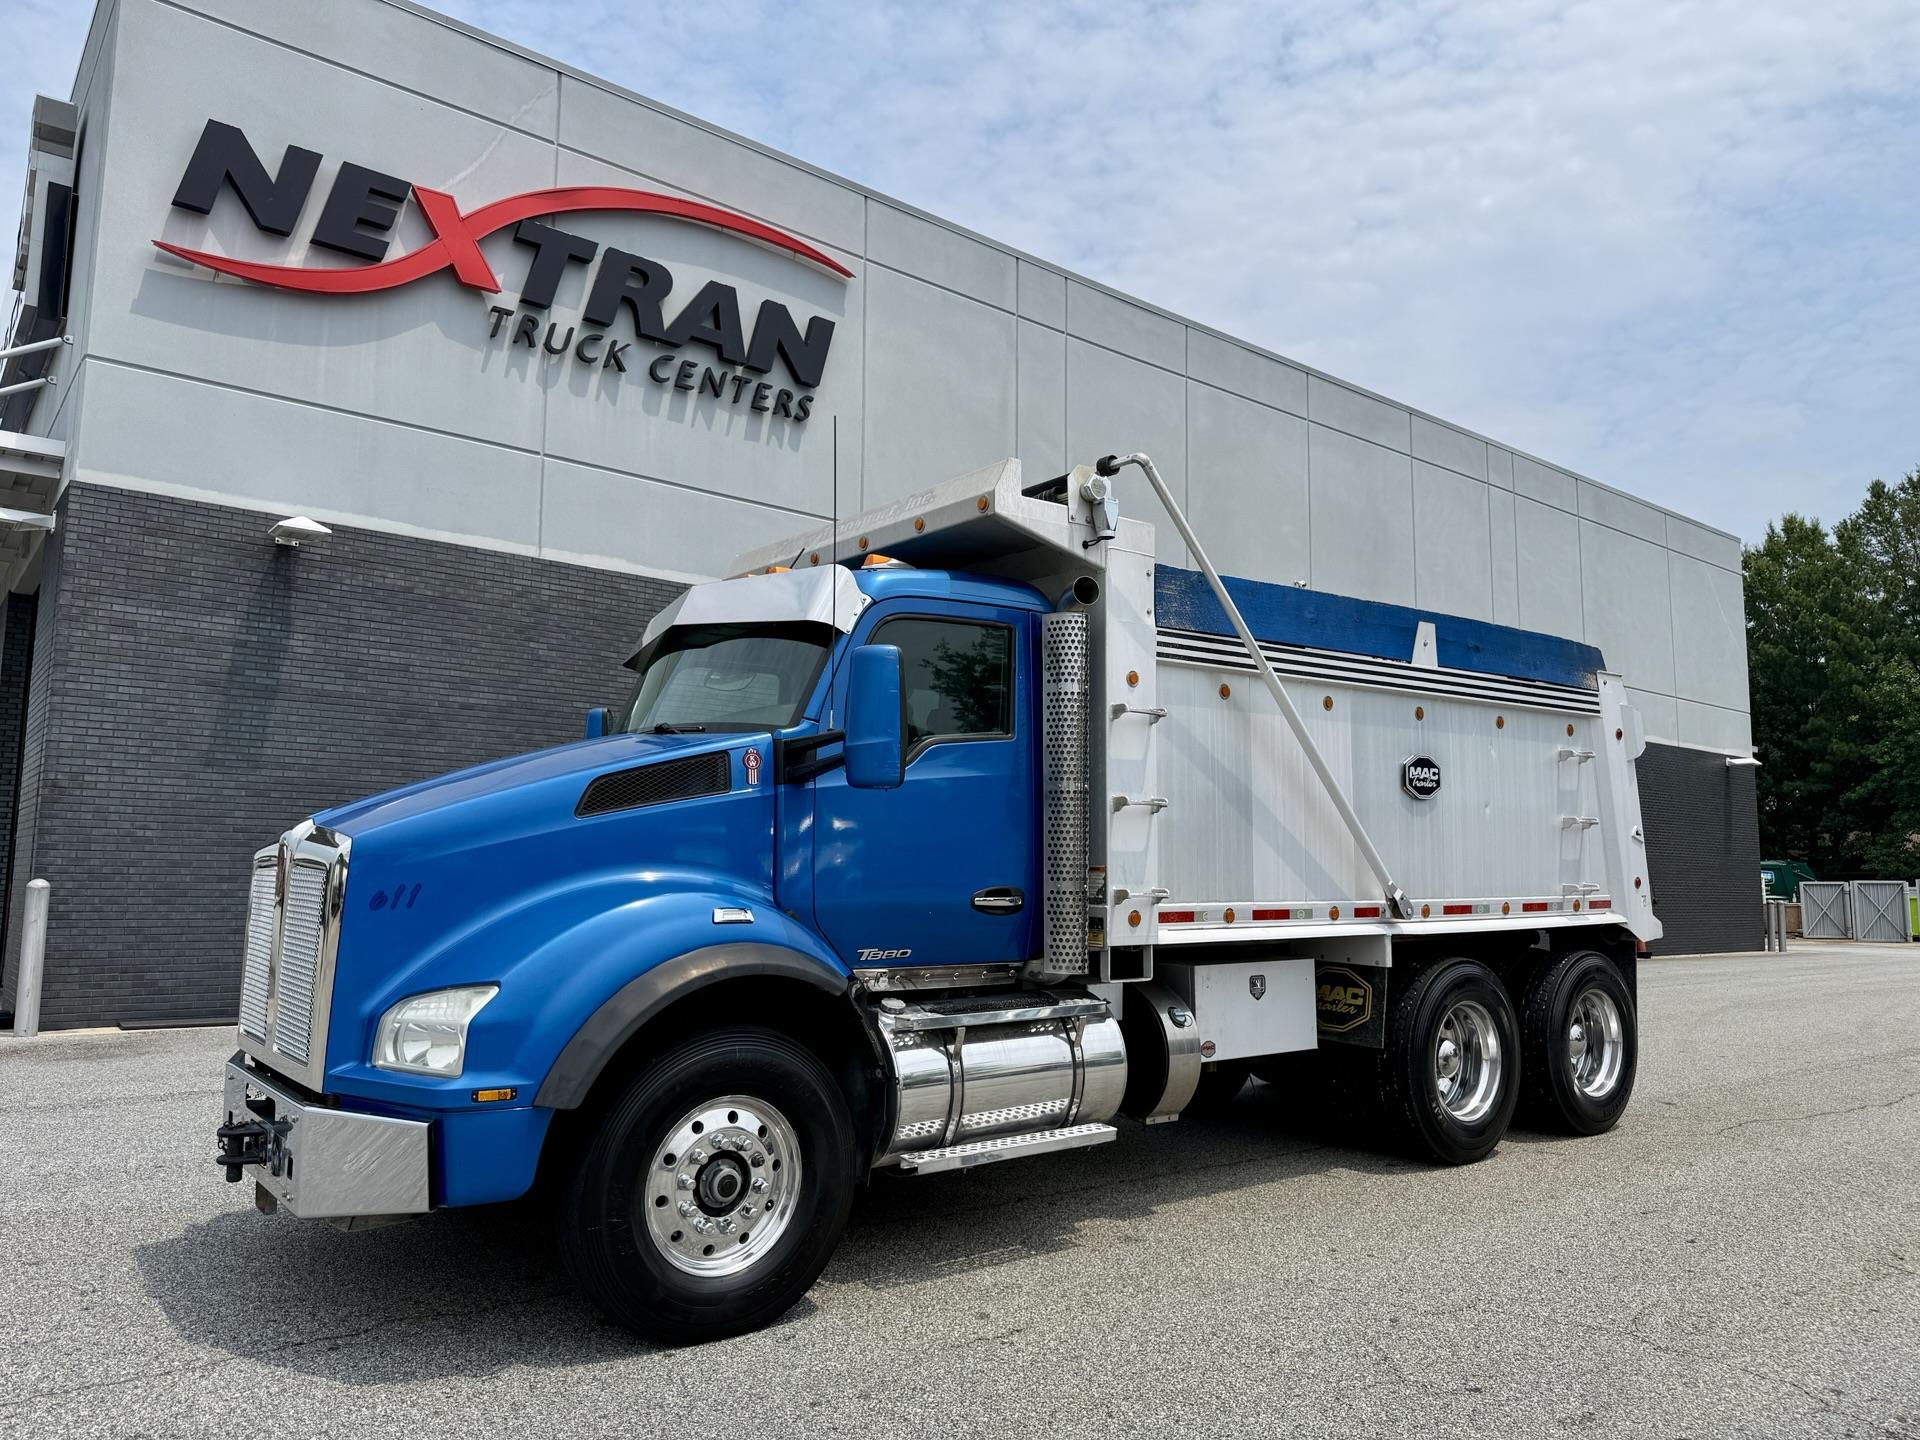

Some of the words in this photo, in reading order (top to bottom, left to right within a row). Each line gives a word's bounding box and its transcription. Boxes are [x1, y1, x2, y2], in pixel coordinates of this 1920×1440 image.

[168, 119, 838, 388] NEXTRAN
[490, 306, 631, 372] TRUCK
[649, 354, 814, 421] CENTERS
[1409, 766, 1439, 780] MAC
[1411, 775, 1437, 787] Trailer
[369, 883, 422, 911] 611
[857, 948, 912, 960] T880
